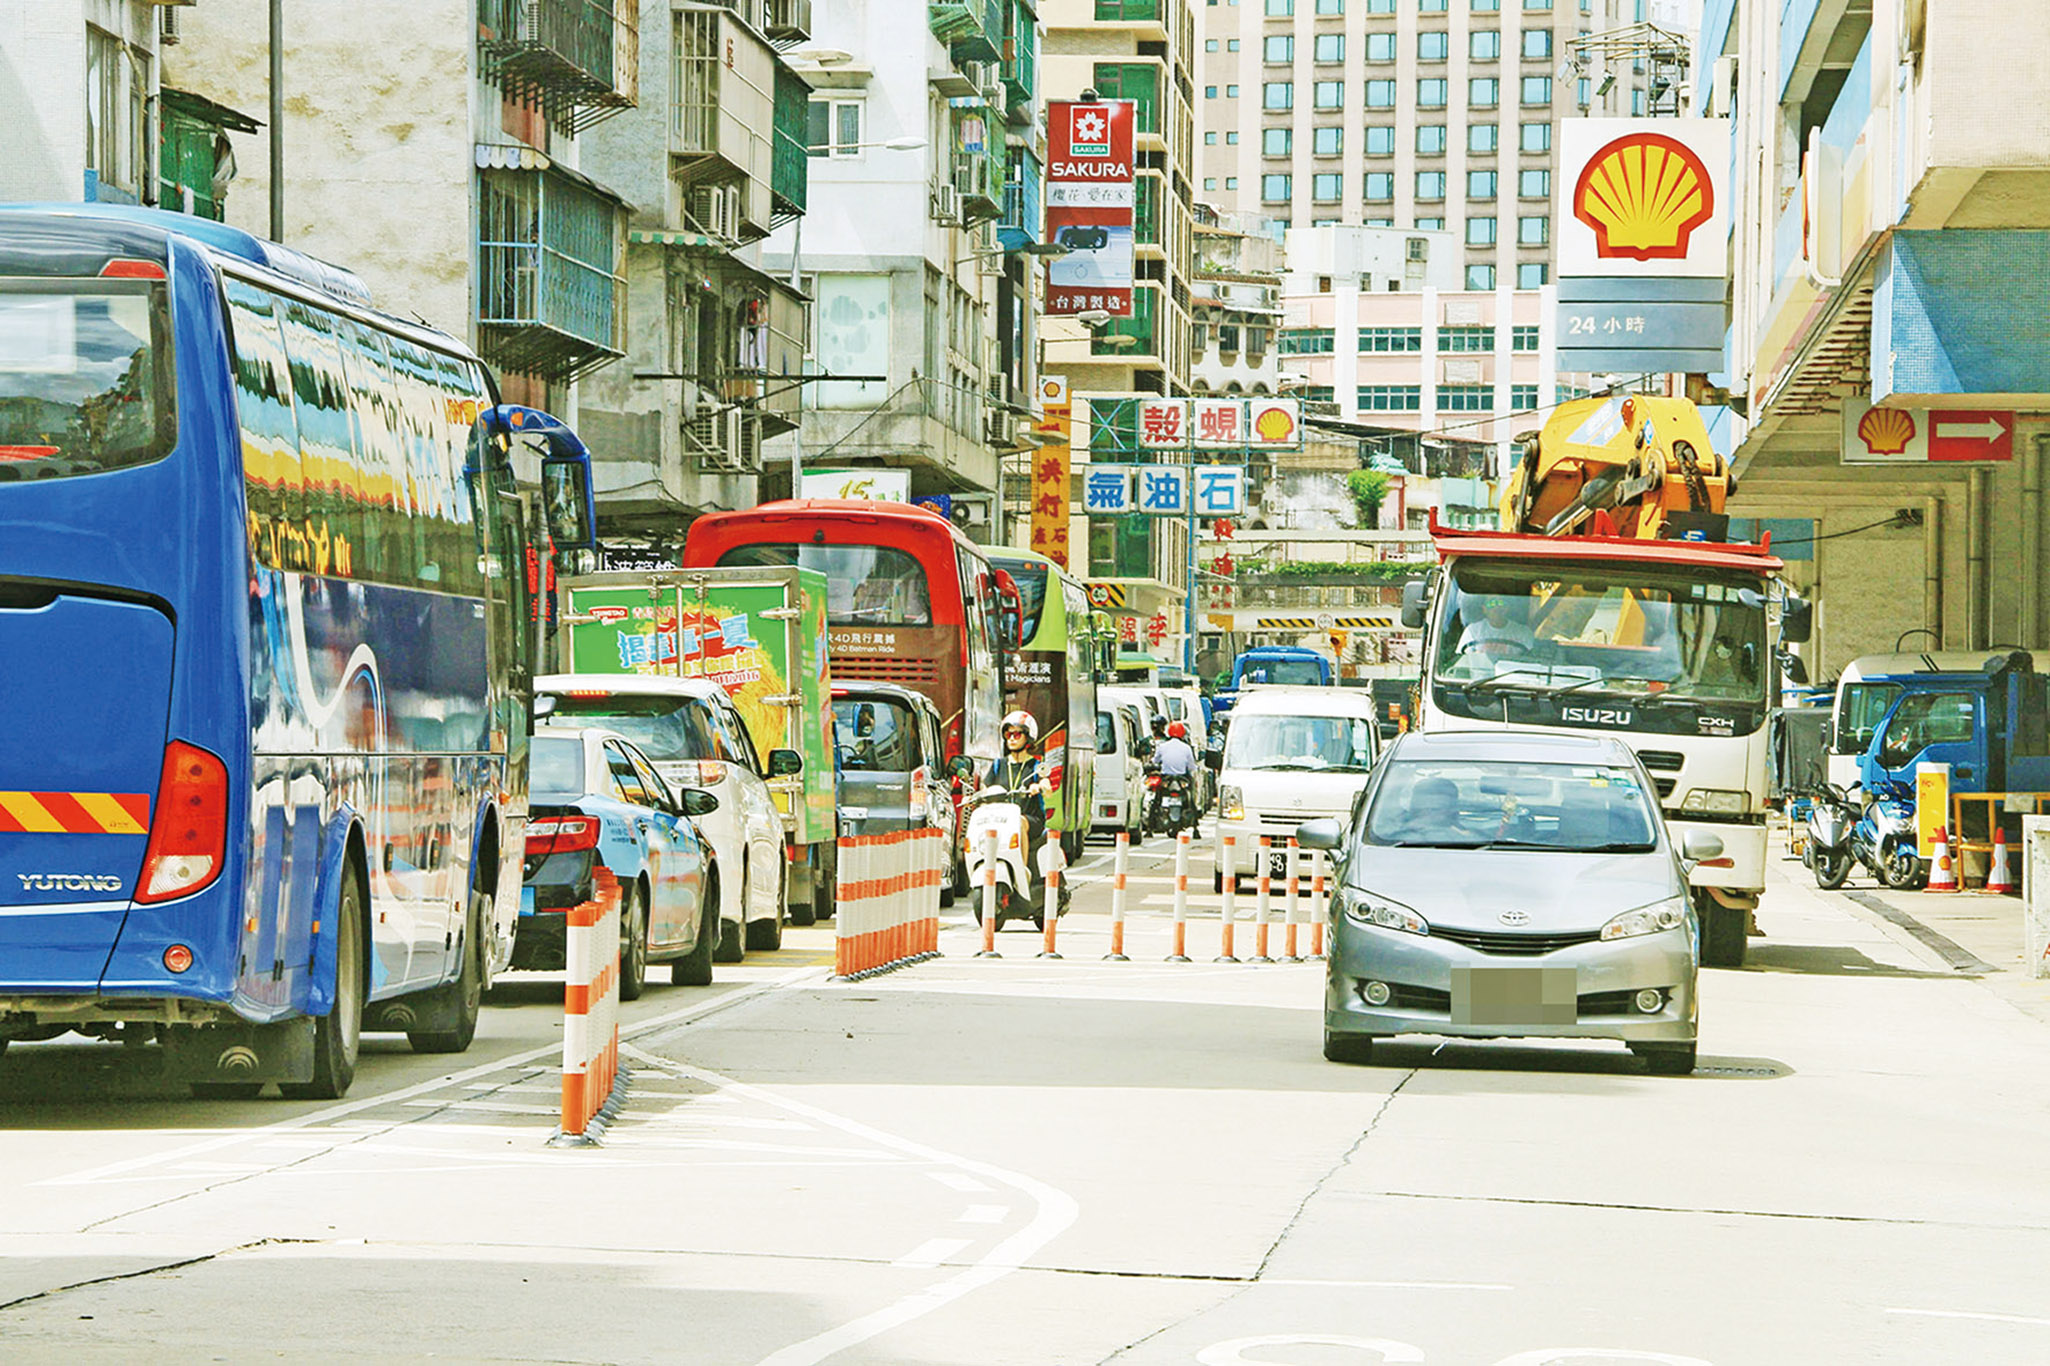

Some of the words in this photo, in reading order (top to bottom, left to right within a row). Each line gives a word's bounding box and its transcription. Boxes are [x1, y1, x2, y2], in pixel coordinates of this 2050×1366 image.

[1051, 162, 1129, 177] SAKURA
[1568, 316, 1596, 334] 24
[1603, 315, 1645, 334] 小時
[849, 645, 877, 653] Batman
[1011, 674, 1051, 684] Magicians
[1561, 707, 1631, 725] ISUZU
[1697, 717, 1735, 728] CXH
[17, 874, 122, 892] YUTONG
